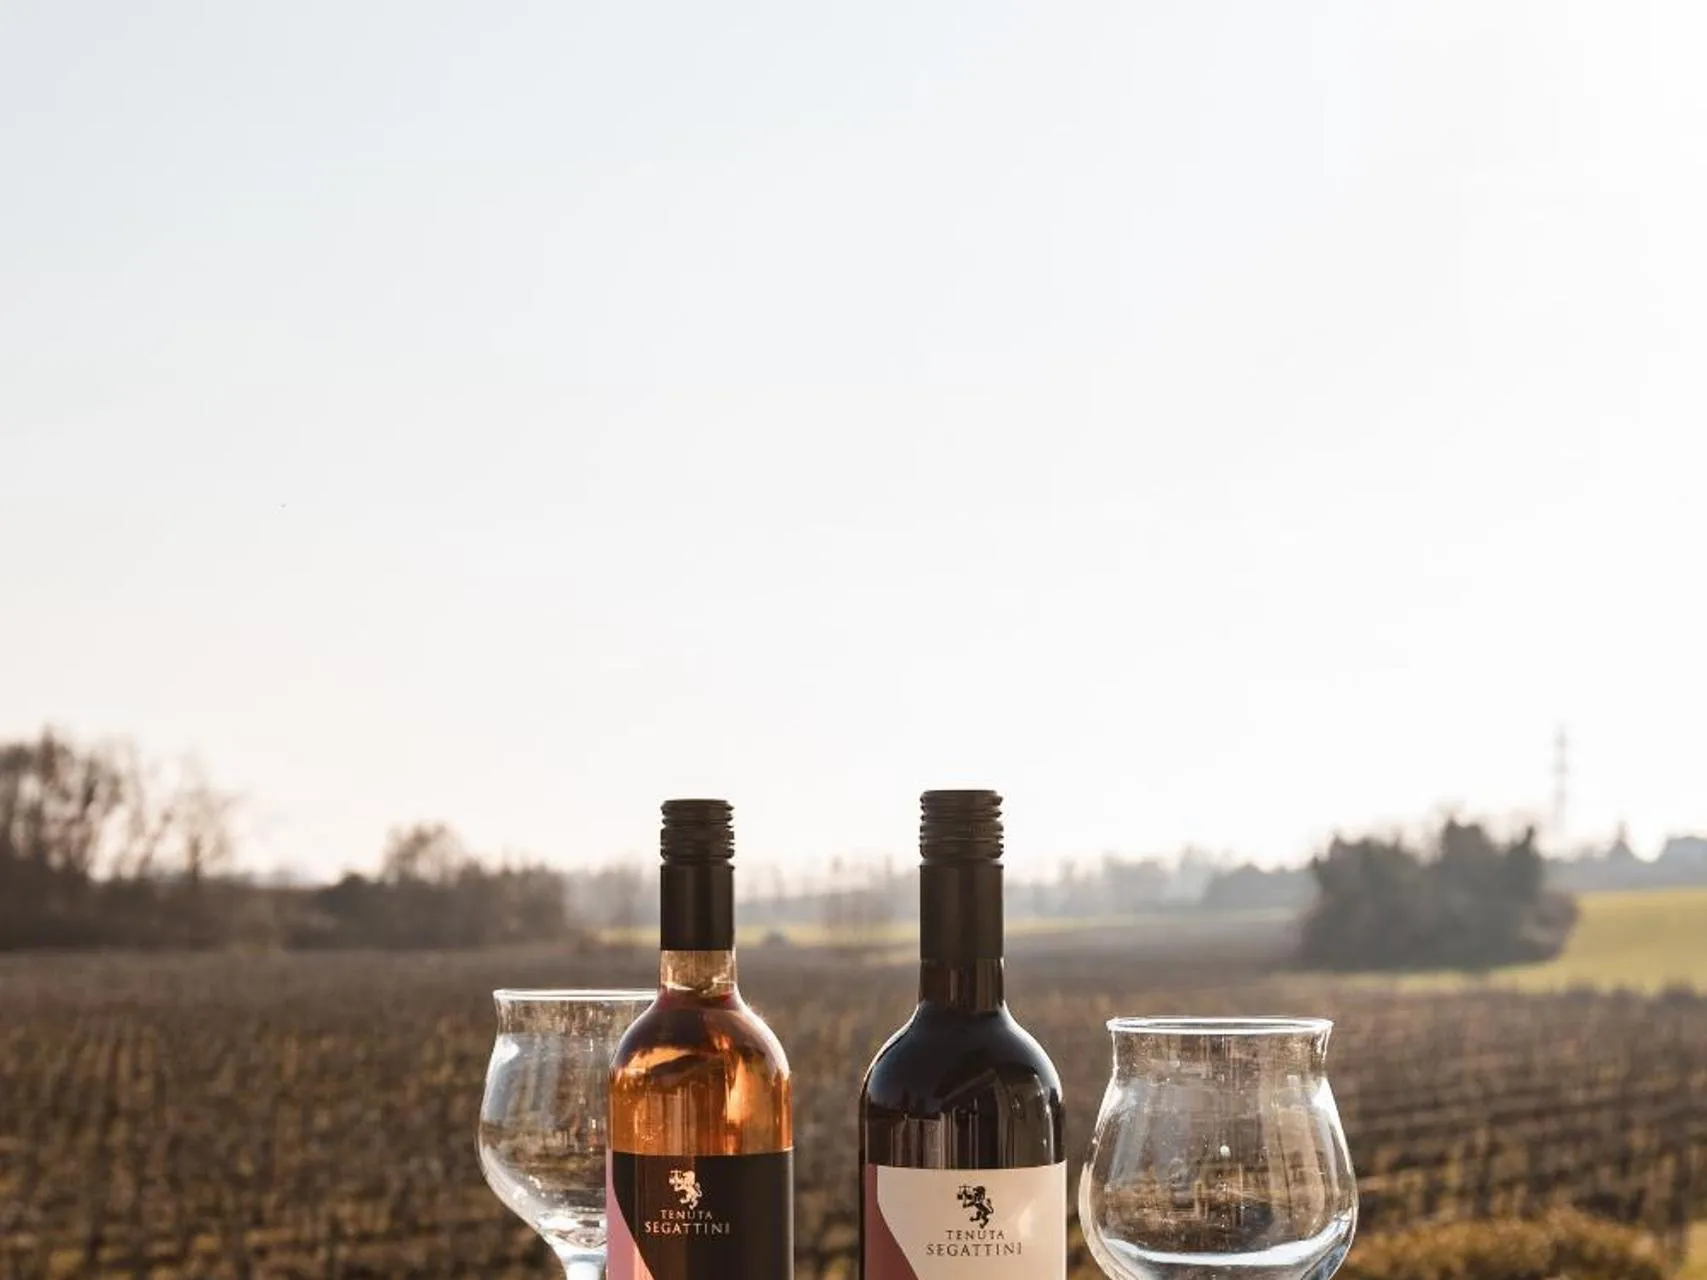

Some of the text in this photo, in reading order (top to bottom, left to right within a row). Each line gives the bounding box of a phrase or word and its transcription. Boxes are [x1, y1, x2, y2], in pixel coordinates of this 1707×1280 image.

[660, 1209, 713, 1220] TENUTA
[644, 1221, 730, 1235] SEGATTINI
[946, 1230, 1005, 1240] TENUTA
[926, 1242, 1023, 1257] SEGATTINI
